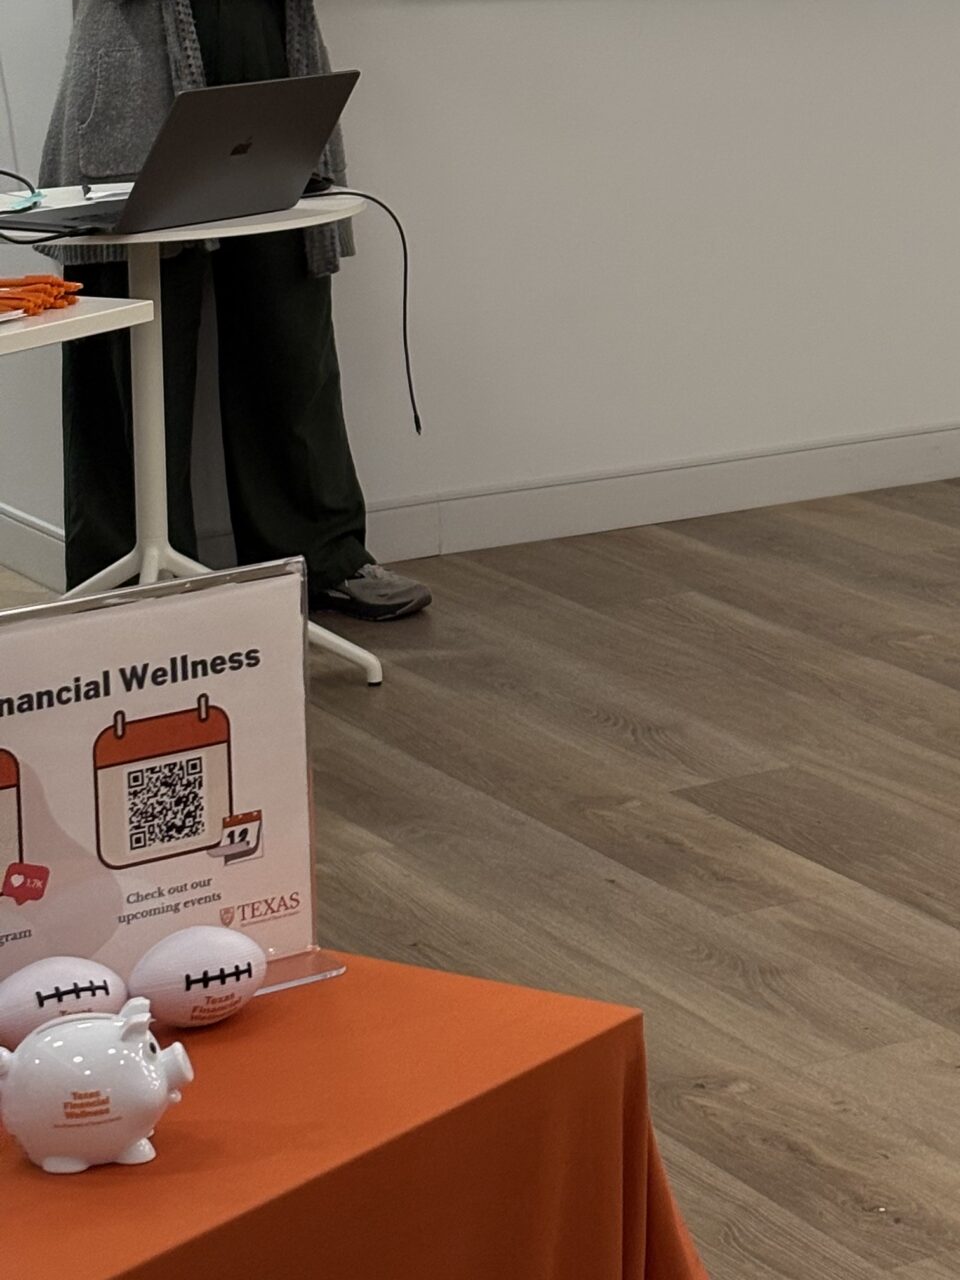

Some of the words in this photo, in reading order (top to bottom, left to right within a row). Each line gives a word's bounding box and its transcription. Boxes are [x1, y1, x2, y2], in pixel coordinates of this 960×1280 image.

[0, 670, 110, 717] nancial
[119, 648, 260, 693] Wellness
[126, 887, 165, 904] Check
[168, 883, 188, 895] out
[191, 877, 212, 892] our
[237, 891, 300, 921] TEXAS
[118, 902, 180, 924] upcoming
[184, 892, 222, 908] events
